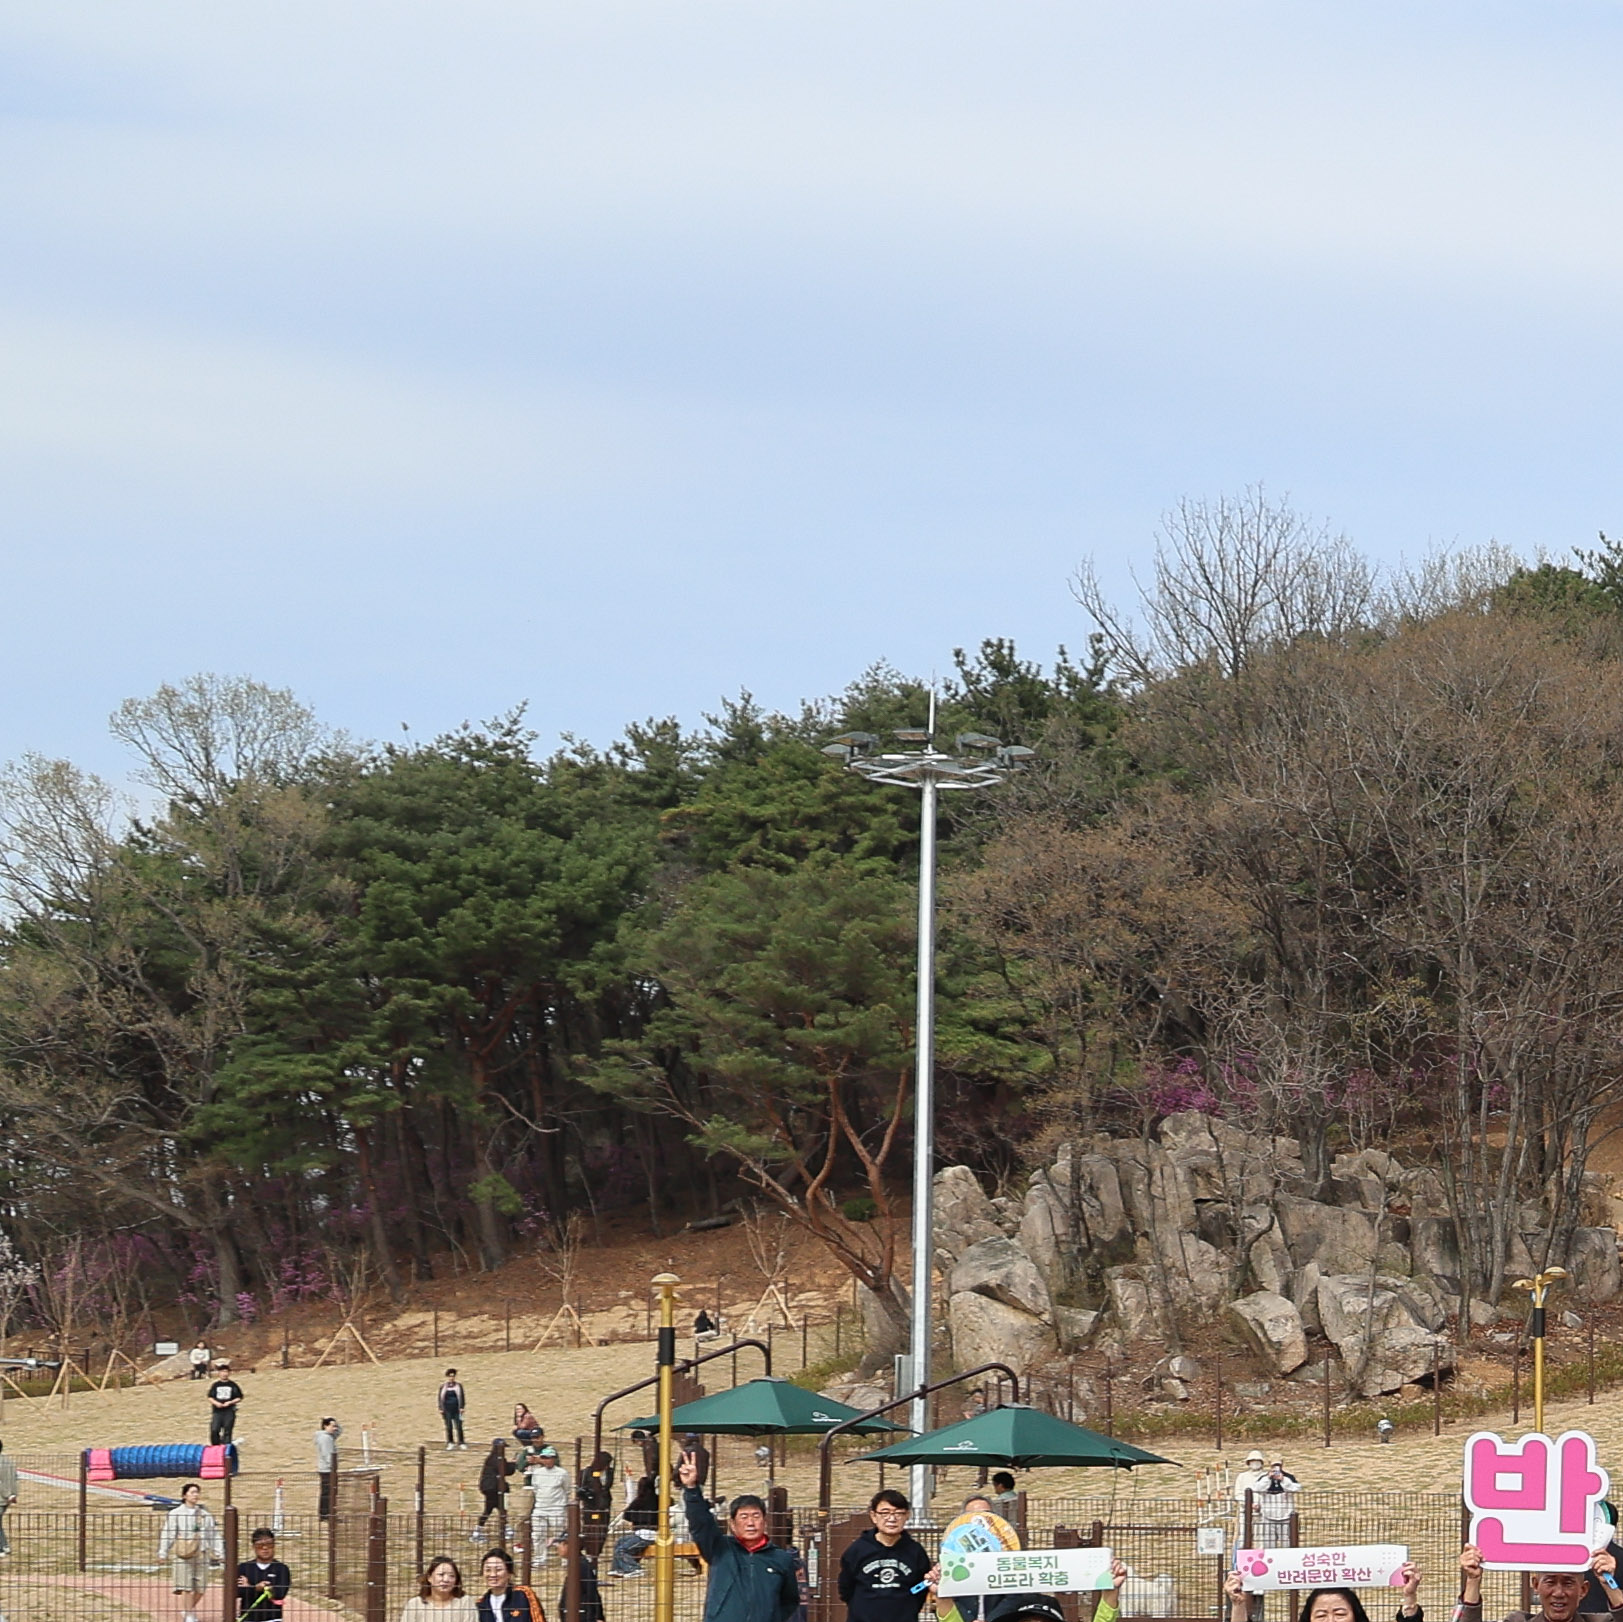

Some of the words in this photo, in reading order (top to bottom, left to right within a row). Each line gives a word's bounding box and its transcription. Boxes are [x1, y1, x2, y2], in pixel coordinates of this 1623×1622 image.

[996, 1556, 1059, 1571] 동물복지
[1302, 1553, 1347, 1567] 성숙한
[986, 1573, 1035, 1590] 인프라
[1038, 1571, 1070, 1587] 확충
[1277, 1568, 1337, 1584] 반려문화
[1341, 1567, 1372, 1582] 확산
